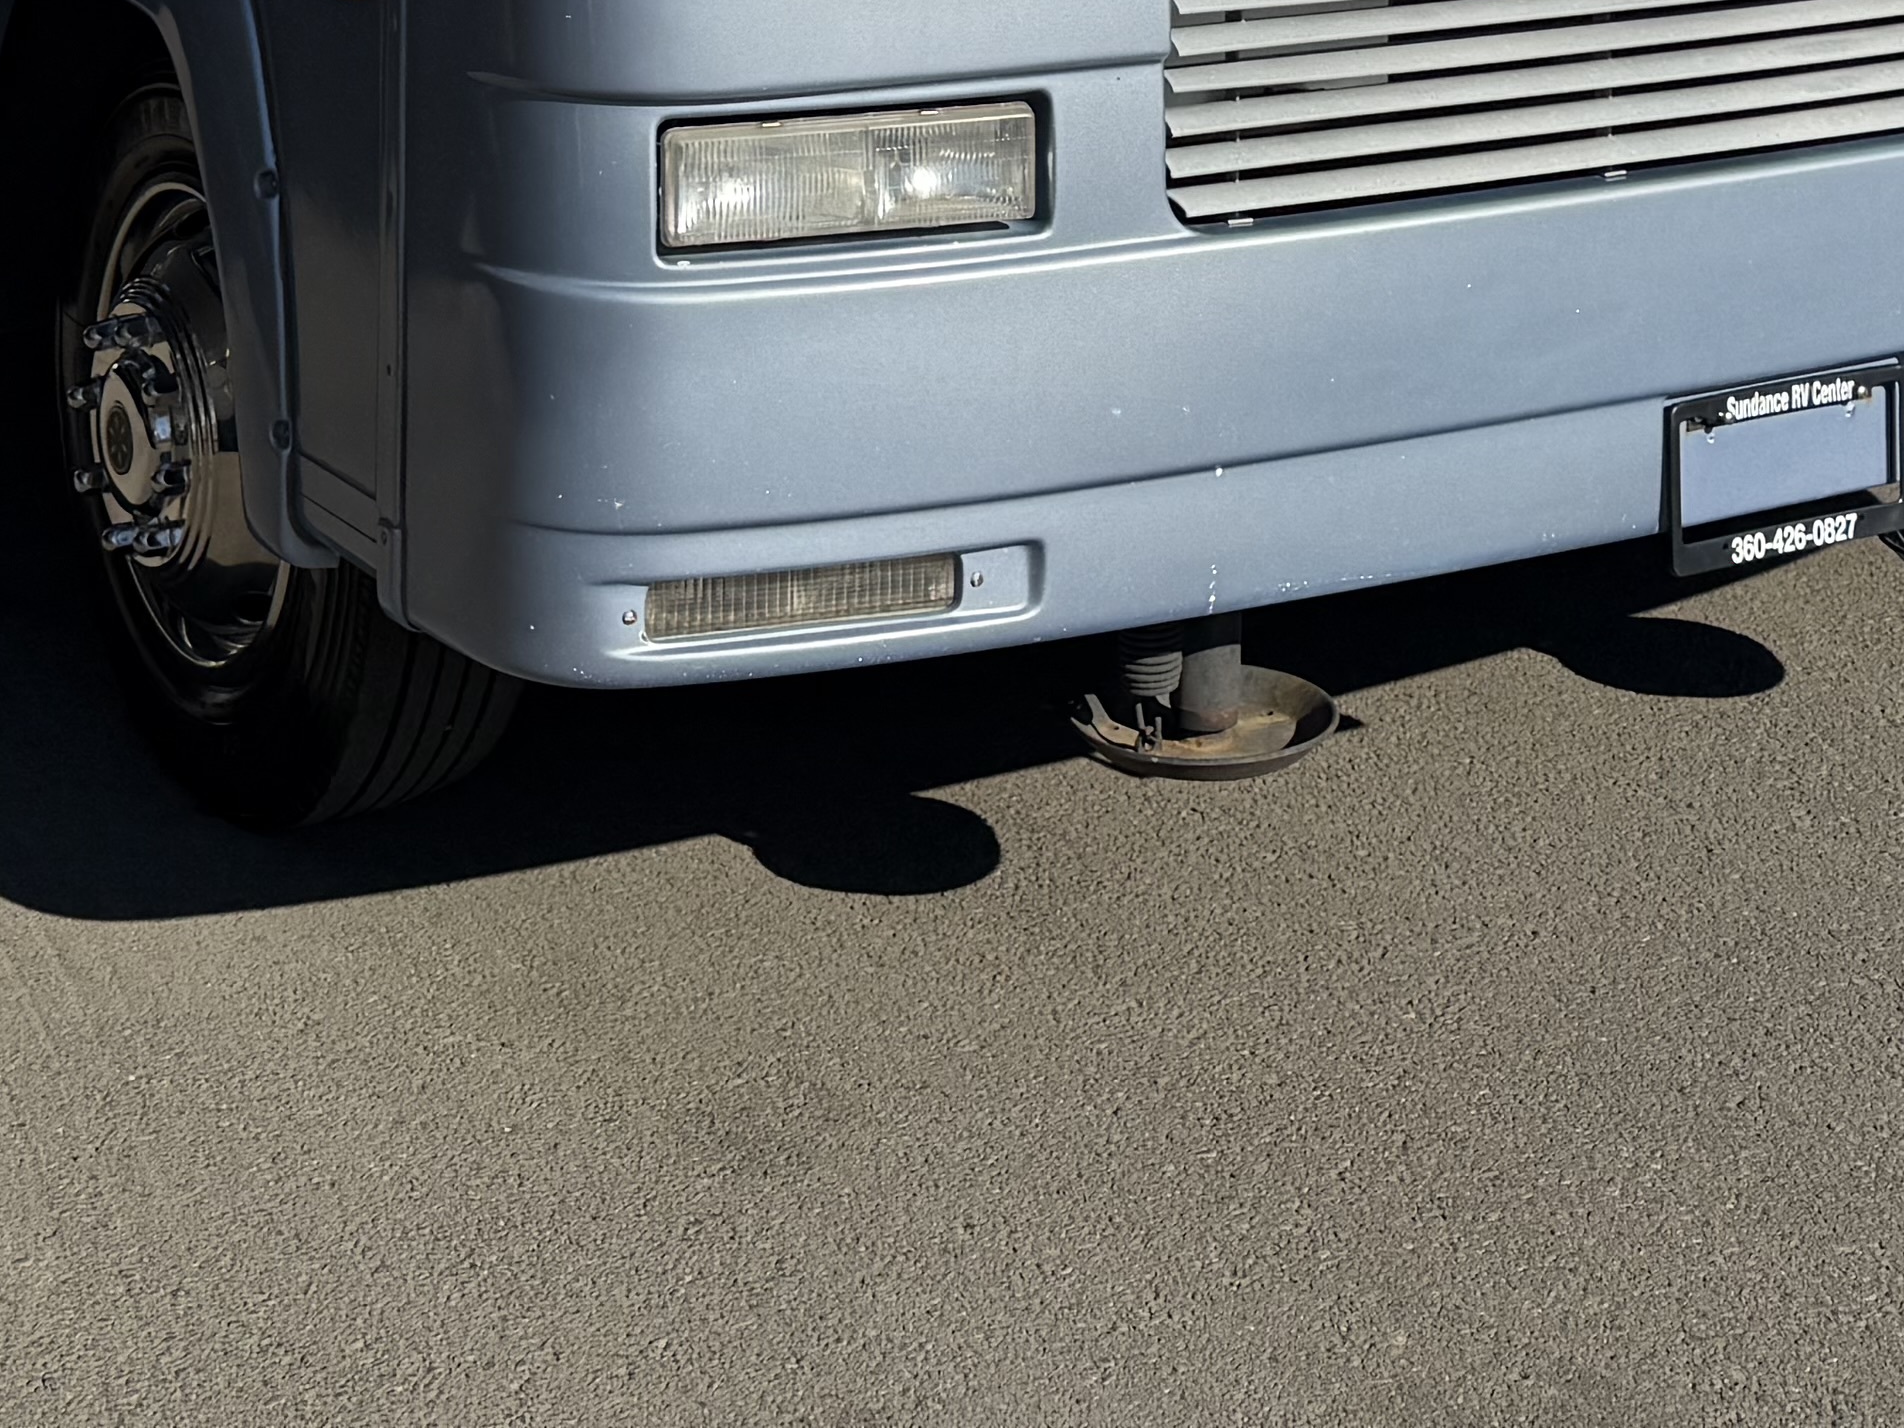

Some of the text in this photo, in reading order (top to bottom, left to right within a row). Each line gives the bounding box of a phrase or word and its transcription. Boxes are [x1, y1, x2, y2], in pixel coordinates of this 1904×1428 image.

[1726, 377, 1856, 421] Sundance RV Center
[1730, 512, 1859, 565] 360-426-0827
